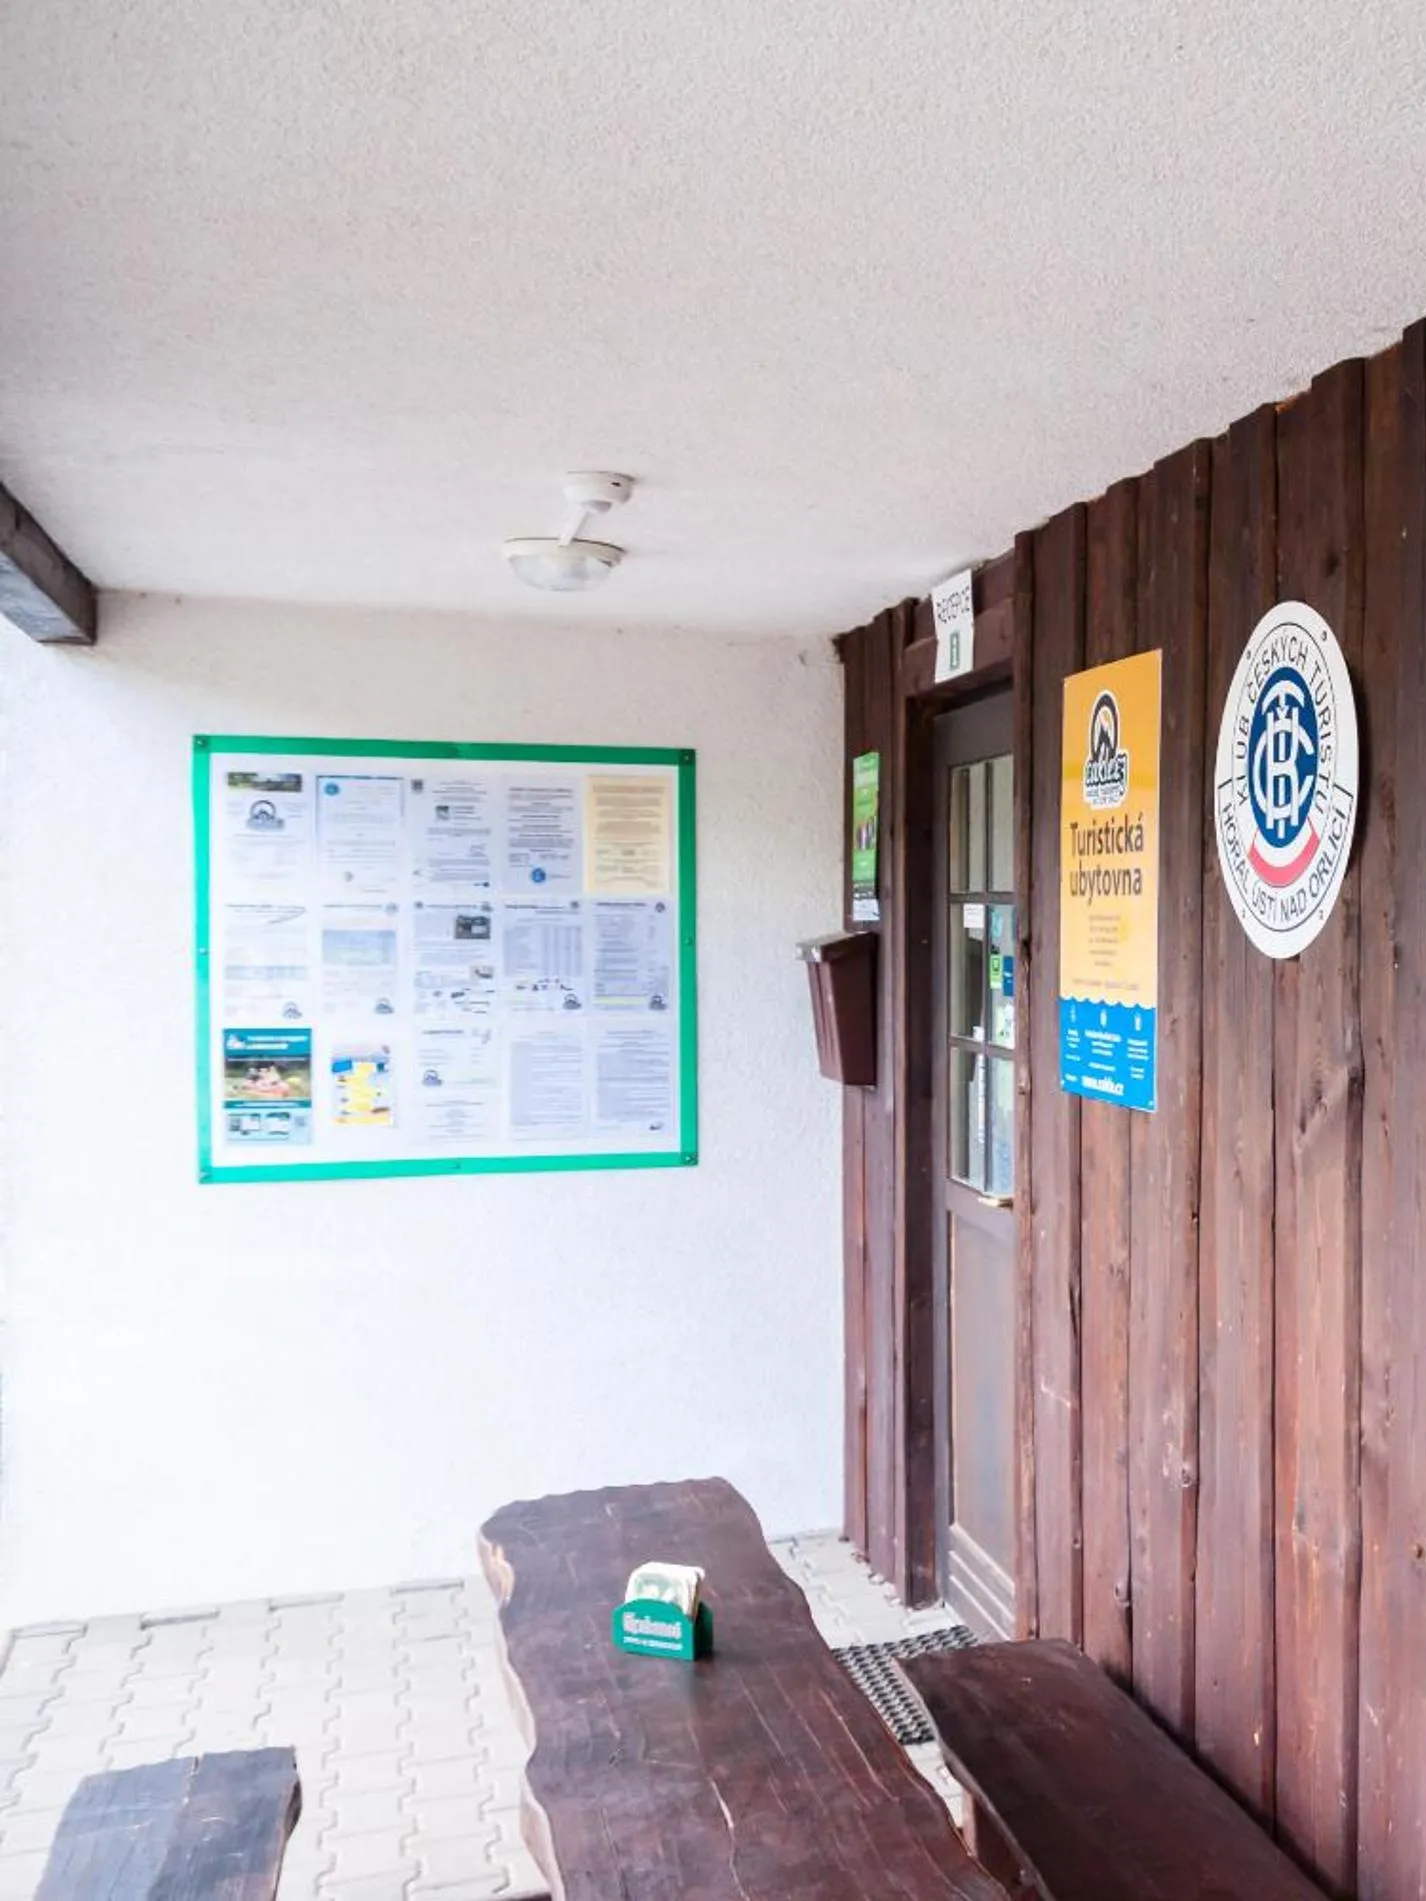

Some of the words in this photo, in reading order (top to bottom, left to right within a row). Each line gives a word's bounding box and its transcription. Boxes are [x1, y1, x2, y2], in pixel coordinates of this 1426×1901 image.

[1069, 811, 1144, 857] Turistická
[1069, 859, 1142, 906] ubytovna
[1280, 887, 1308, 923] NAD
